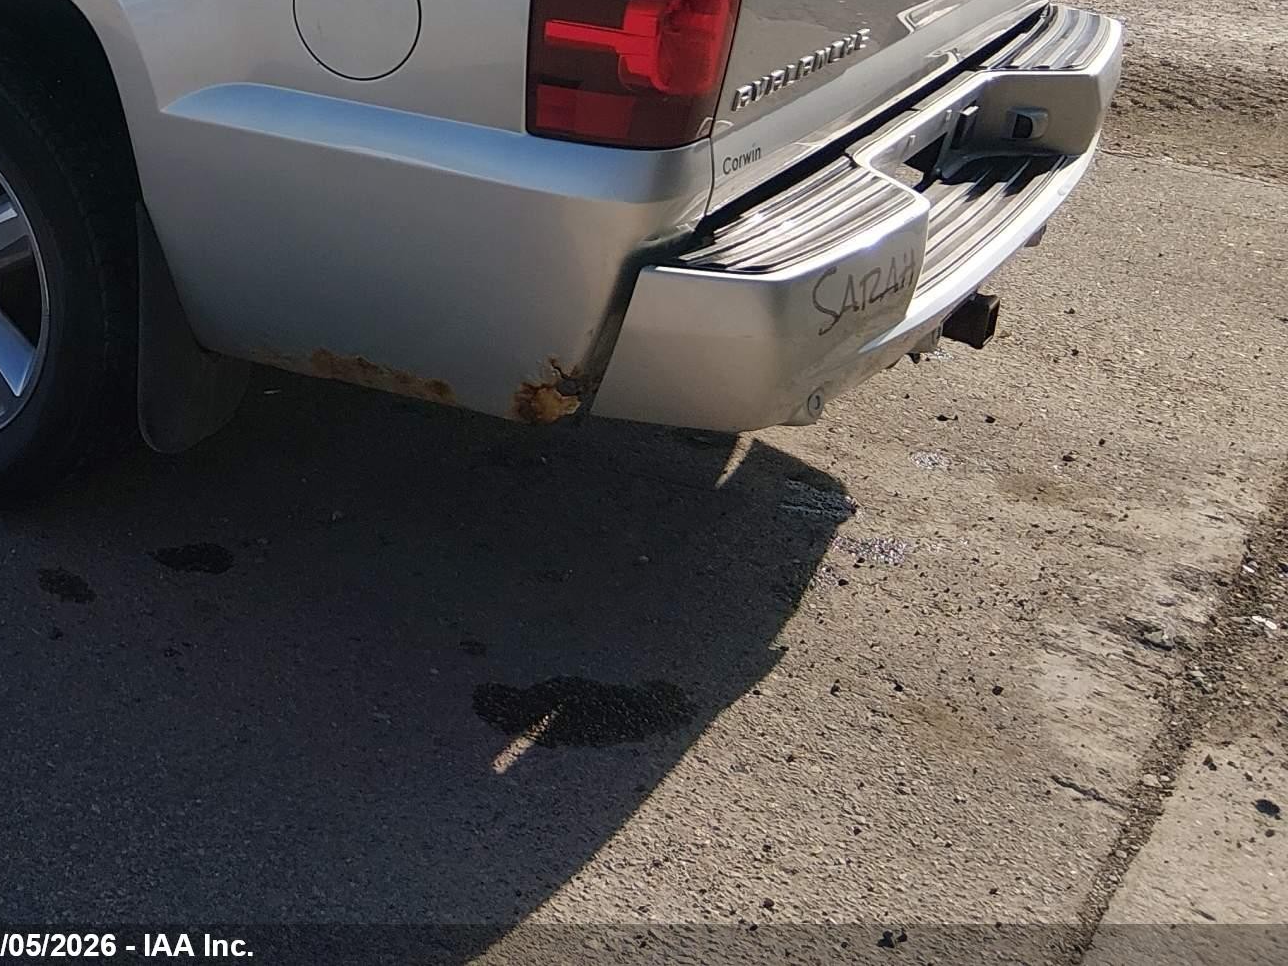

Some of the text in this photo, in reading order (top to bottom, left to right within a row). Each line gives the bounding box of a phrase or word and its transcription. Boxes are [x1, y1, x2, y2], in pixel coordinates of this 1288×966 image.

[731, 28, 871, 112] AVALANCHE
[722, 144, 762, 175] Corwin
[812, 250, 916, 336] SARAH
